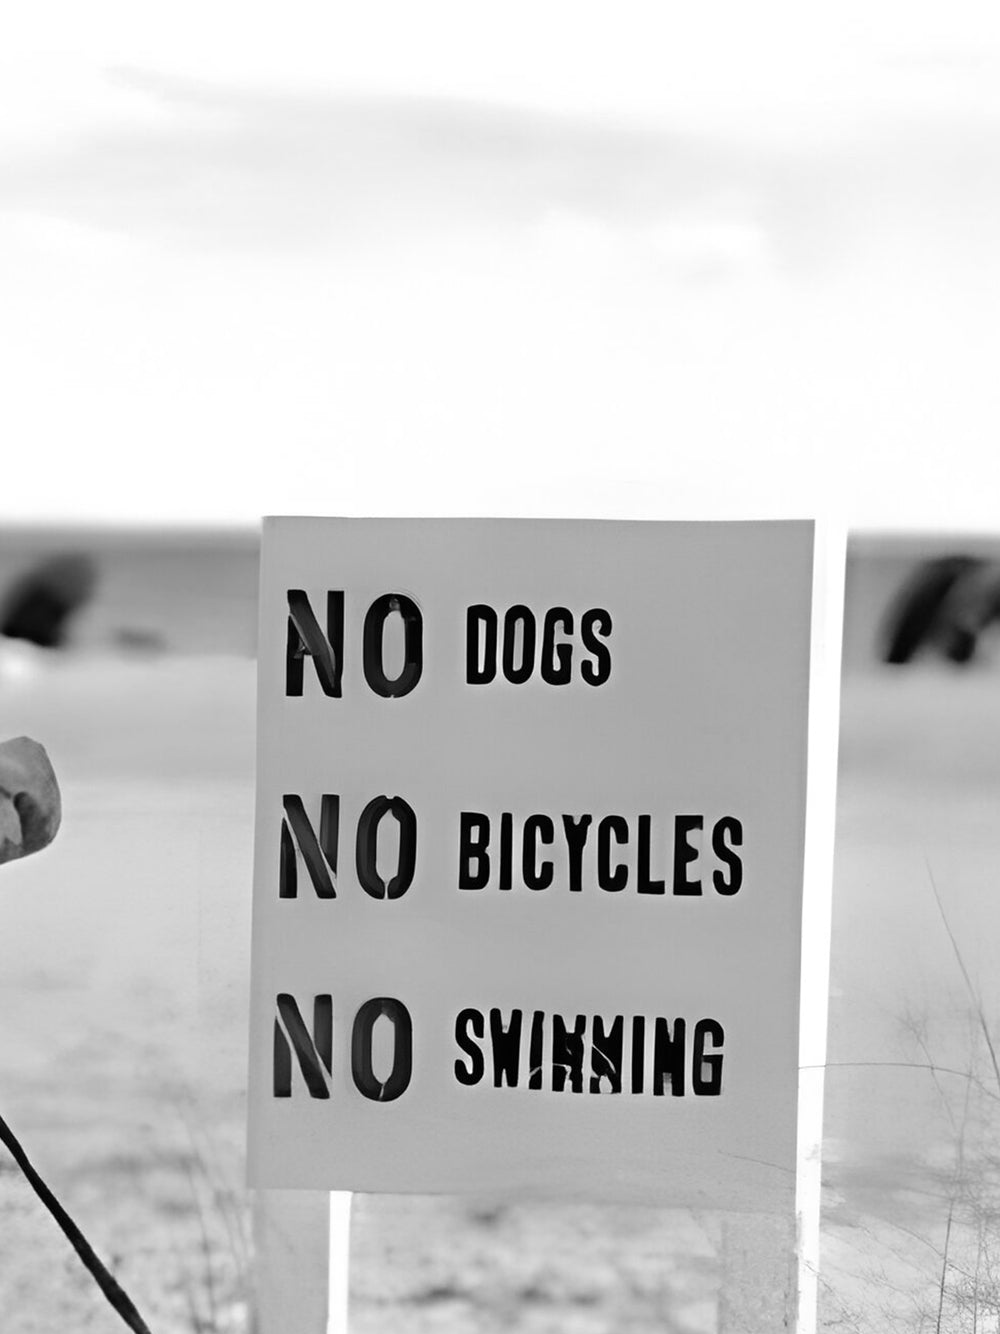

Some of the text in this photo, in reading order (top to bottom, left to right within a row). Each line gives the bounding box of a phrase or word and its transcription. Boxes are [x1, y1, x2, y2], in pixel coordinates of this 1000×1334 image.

[285, 588, 613, 699] NO DOGS
[278, 793, 743, 900] NO BICYCLES
[273, 992, 413, 1103] NO
